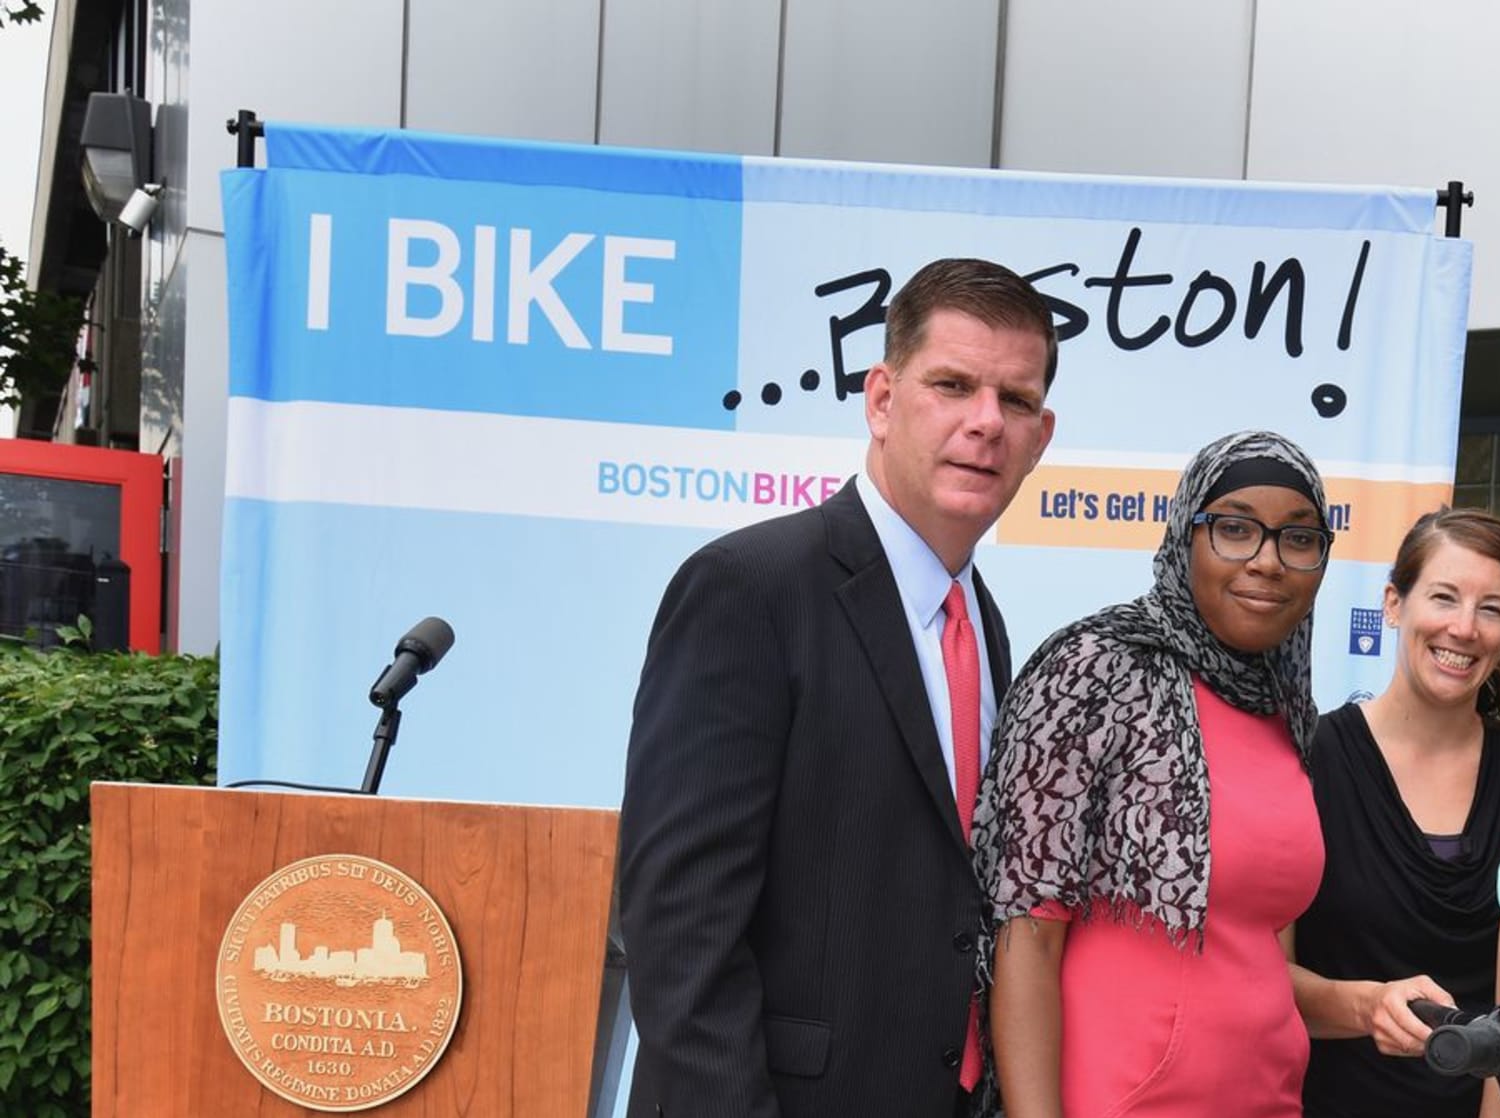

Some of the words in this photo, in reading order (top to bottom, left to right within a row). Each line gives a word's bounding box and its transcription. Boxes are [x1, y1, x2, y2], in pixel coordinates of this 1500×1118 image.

[306, 213, 332, 331] I
[385, 217, 677, 356] BIKE
[598, 460, 841, 508] BOSTONBIKE
[1040, 488, 1099, 520] Let's
[1105, 491, 1146, 523] Get
[226, 912, 256, 963] SICUT
[254, 862, 332, 911] PATRIBUS
[336, 862, 368, 879] SIT
[371, 870, 418, 906] DEUS
[271, 1032, 354, 1056] CONDITA
[261, 1059, 340, 1101] REGIMINE
[346, 1066, 414, 1101] DONATA
